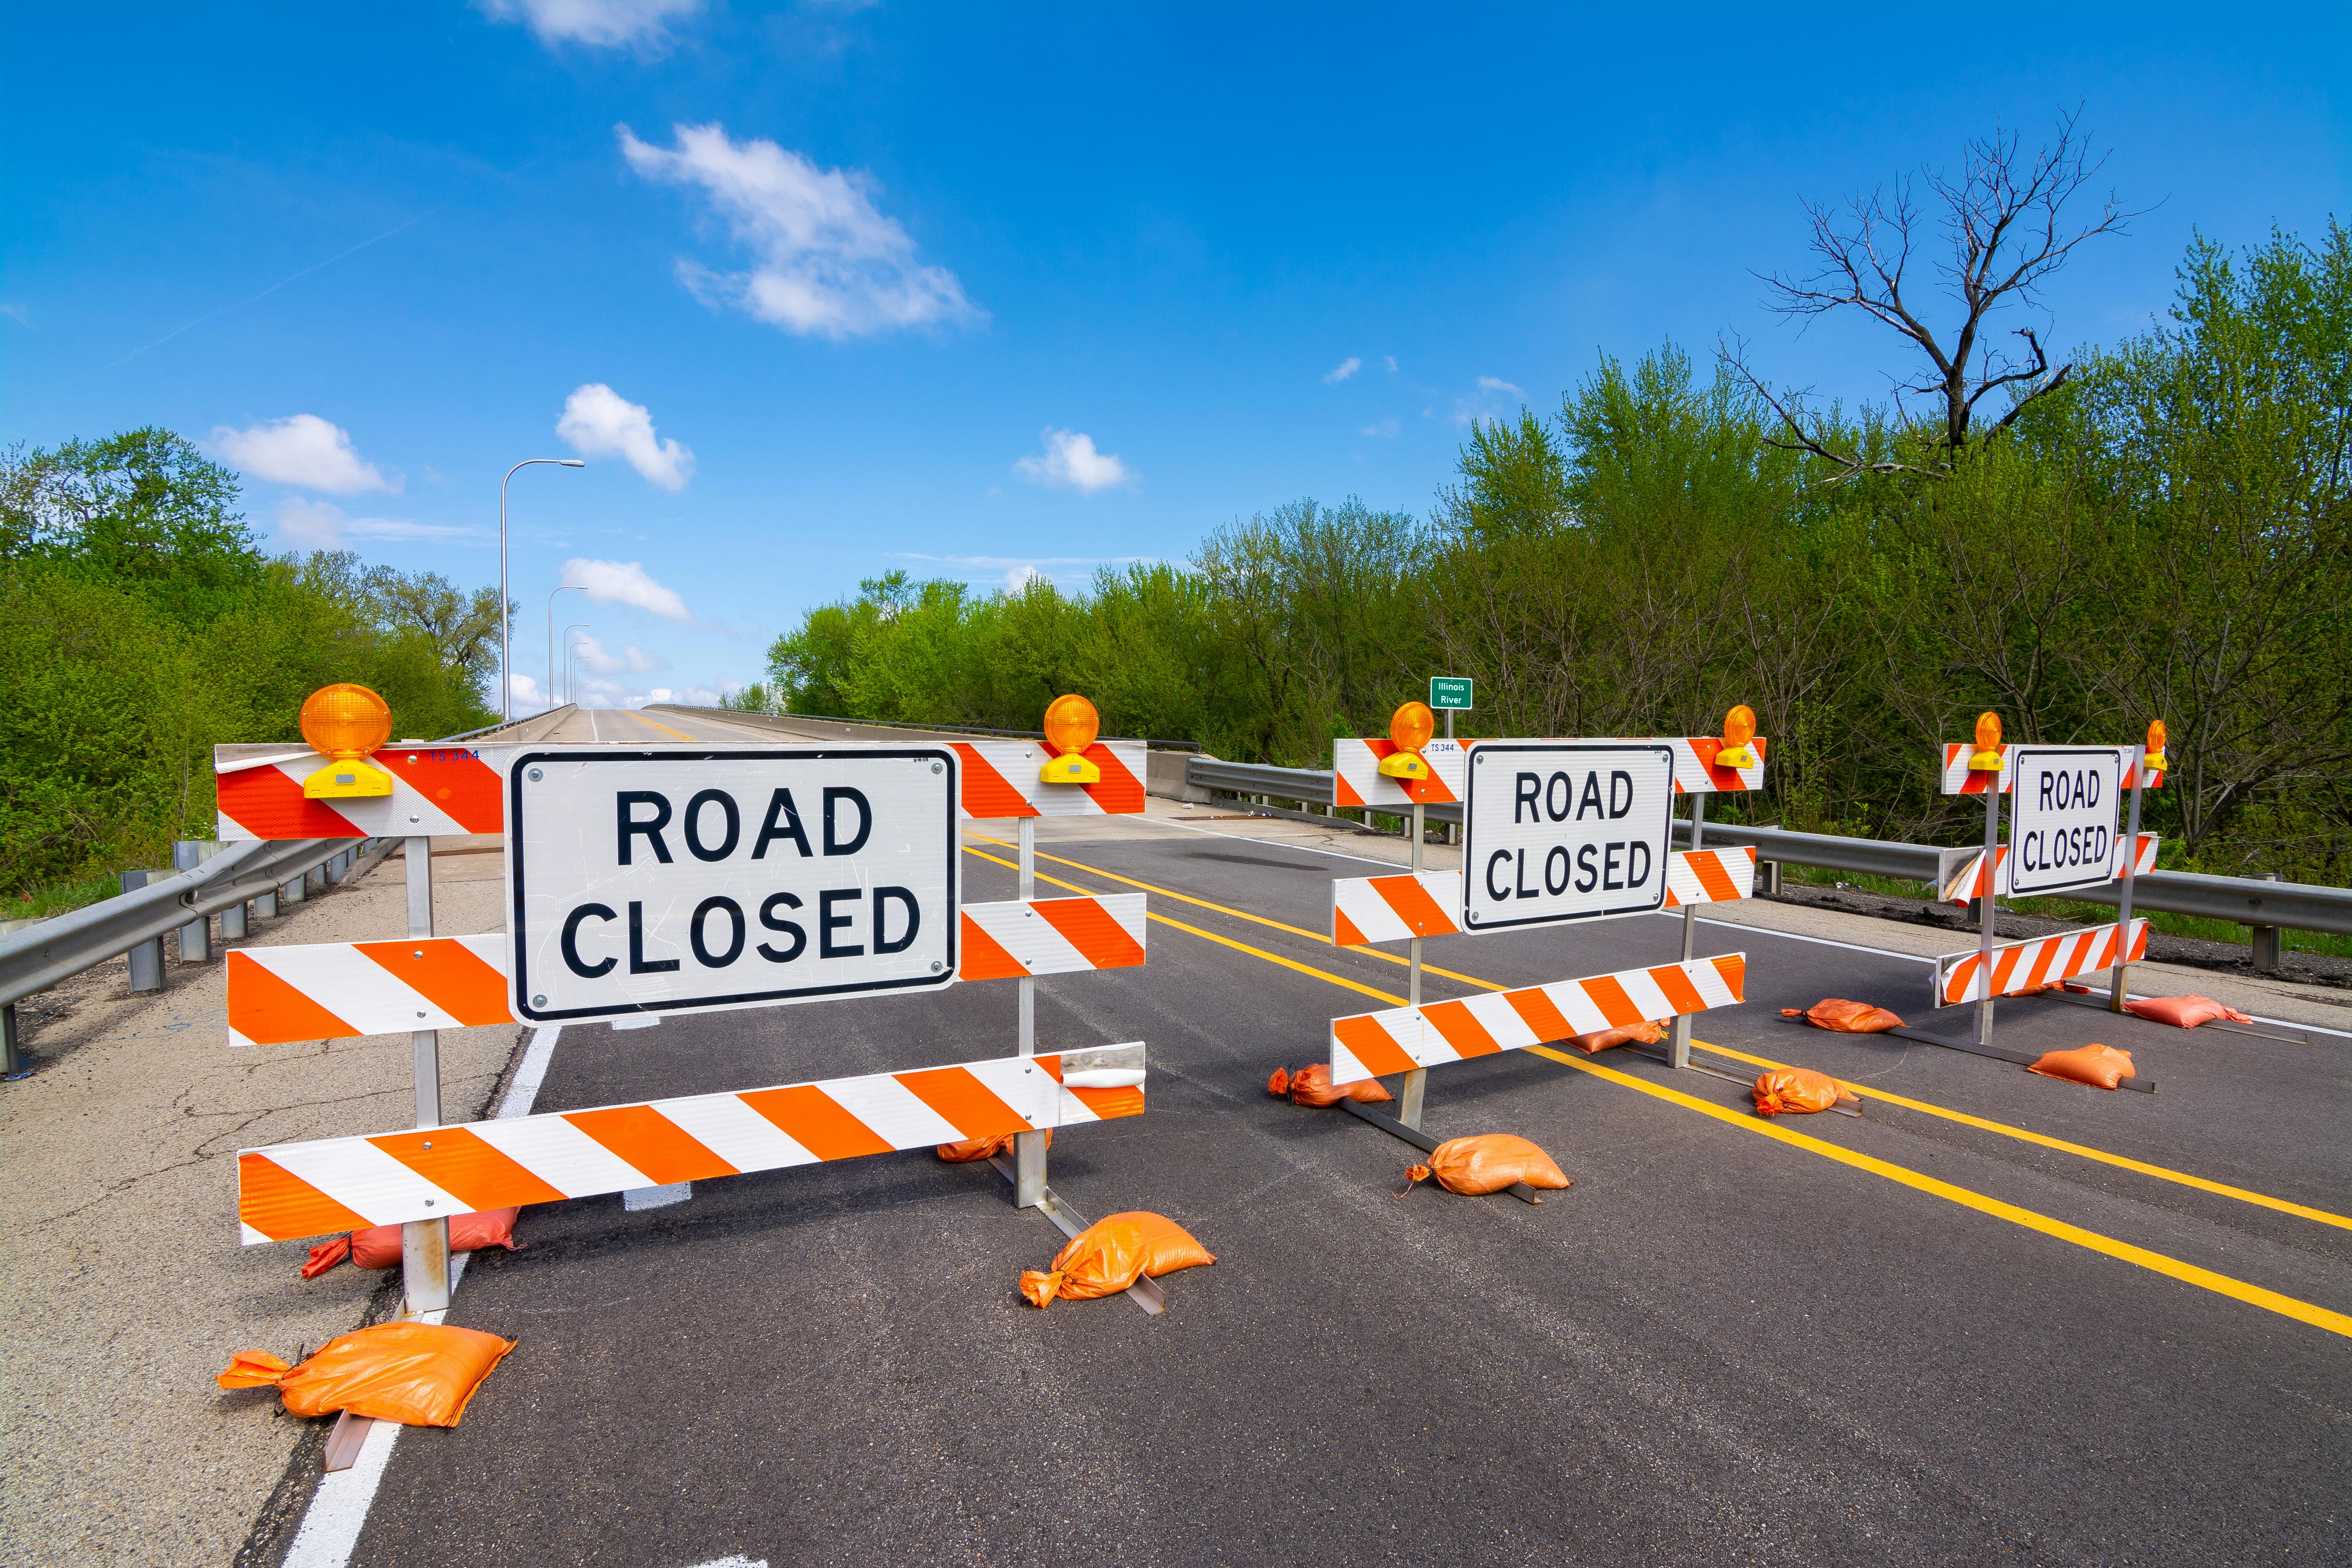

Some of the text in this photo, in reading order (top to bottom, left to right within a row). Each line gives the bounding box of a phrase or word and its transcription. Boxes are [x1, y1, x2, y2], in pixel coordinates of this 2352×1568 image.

[1438, 682, 1465, 691] Illinois
[1441, 695, 1462, 704] River
[429, 750, 479, 761] TS 344
[1515, 770, 1633, 824] ROAD
[2040, 770, 2100, 811] ROAD
[617, 787, 872, 866] ROAD
[2023, 825, 2107, 872] CLOSED
[1486, 840, 1651, 902] CLOSED
[561, 886, 920, 979] CLOSED
